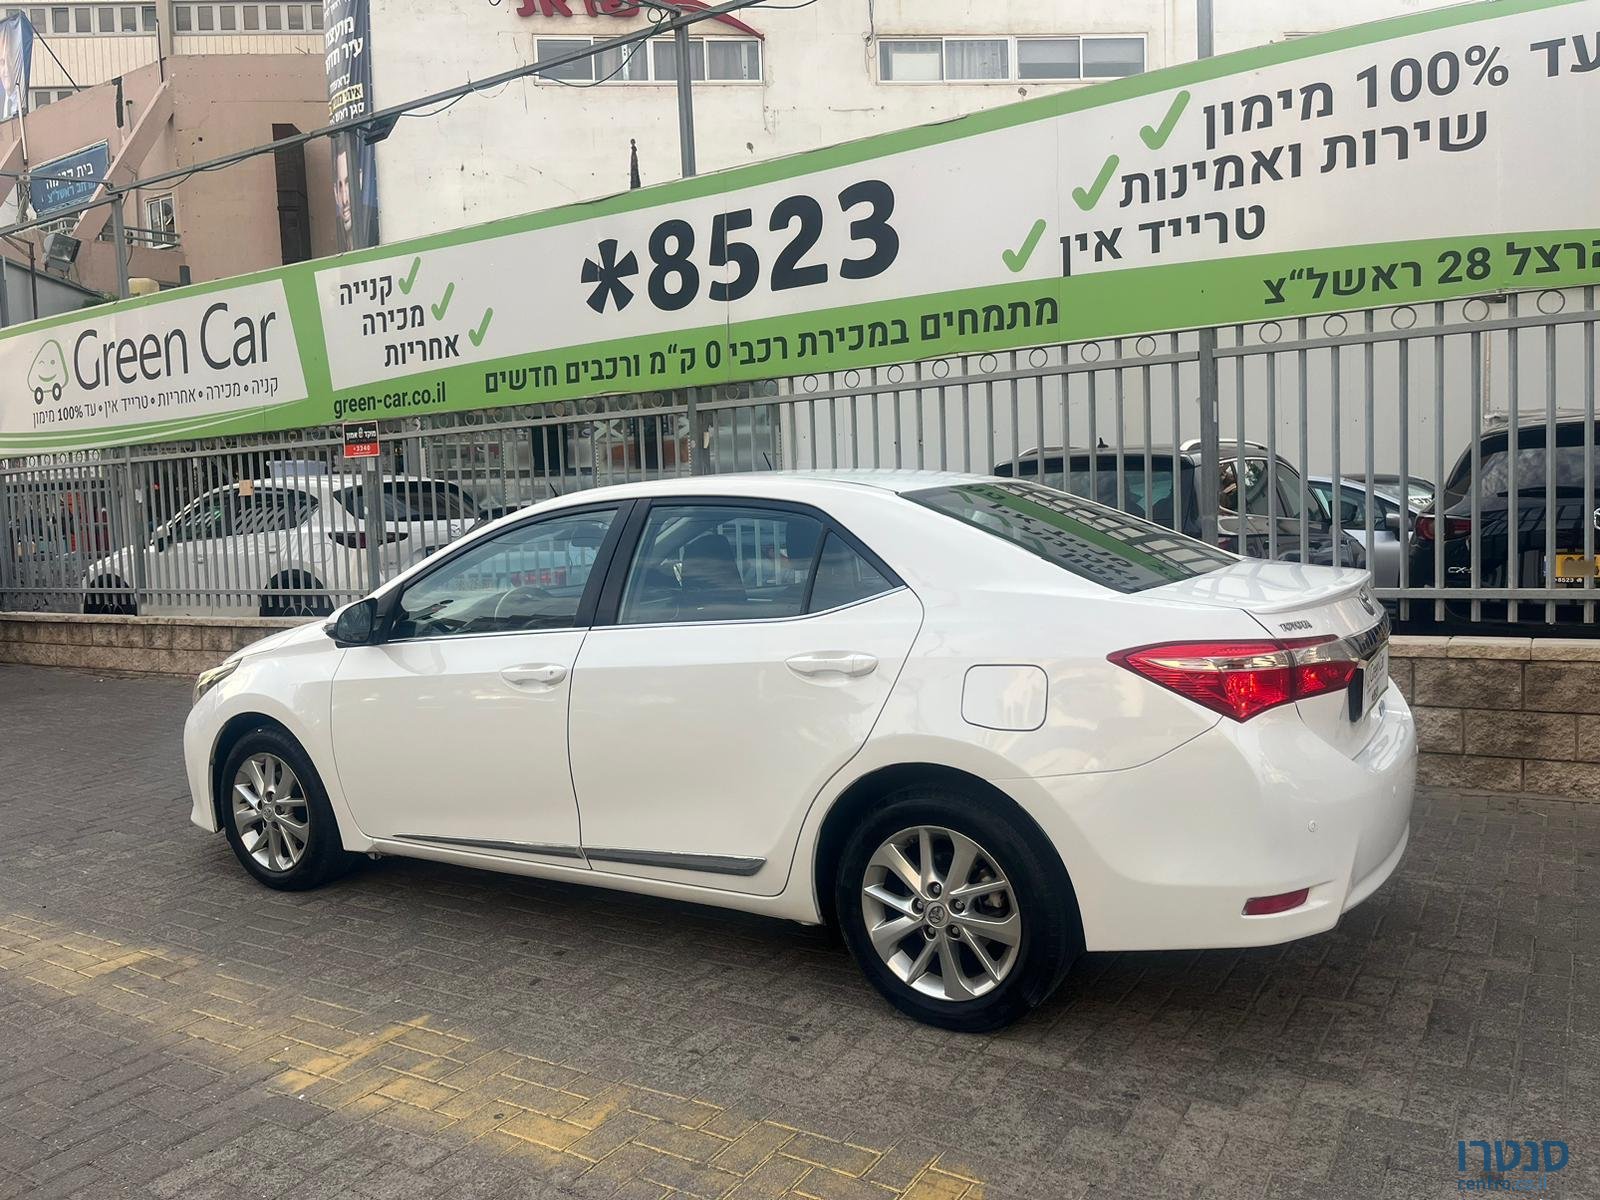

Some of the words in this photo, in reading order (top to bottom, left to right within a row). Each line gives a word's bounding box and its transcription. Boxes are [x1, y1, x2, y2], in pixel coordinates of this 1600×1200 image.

[342, 37, 364, 59] עיר
[1530, 31, 1600, 77] עד
[1356, 45, 1509, 109] 100%
[1203, 81, 1334, 150] מימון
[1320, 110, 1488, 173] שירות
[76, 163, 94, 178] בית
[1119, 142, 1302, 208] ואמינות
[1138, 203, 1266, 254] טרייד
[1060, 226, 1123, 277] אין
[1437, 246, 1491, 285] 28
[340, 275, 393, 305] קנייה
[363, 304, 425, 335] מכירה
[920, 296, 1059, 341] מתמחים
[74, 328, 189, 390] Green
[200, 302, 276, 370] Car
[384, 334, 460, 367] אחריות
[729, 335, 788, 365] רכבי
[798, 319, 910, 357] במכירת
[566, 354, 641, 384] ורכבים
[705, 340, 721, 369] 0
[206, 381, 241, 400] מכירה
[252, 377, 279, 395] קניה
[485, 364, 558, 393] חדשים
[84, 403, 97, 417] עד
[104, 398, 119, 418] אין
[121, 394, 150, 411] טרייד
[157, 387, 197, 407] אחריות
[333, 381, 446, 418] green-car.co.il
[33, 410, 55, 428] מימון
[58, 404, 83, 421] 100%
